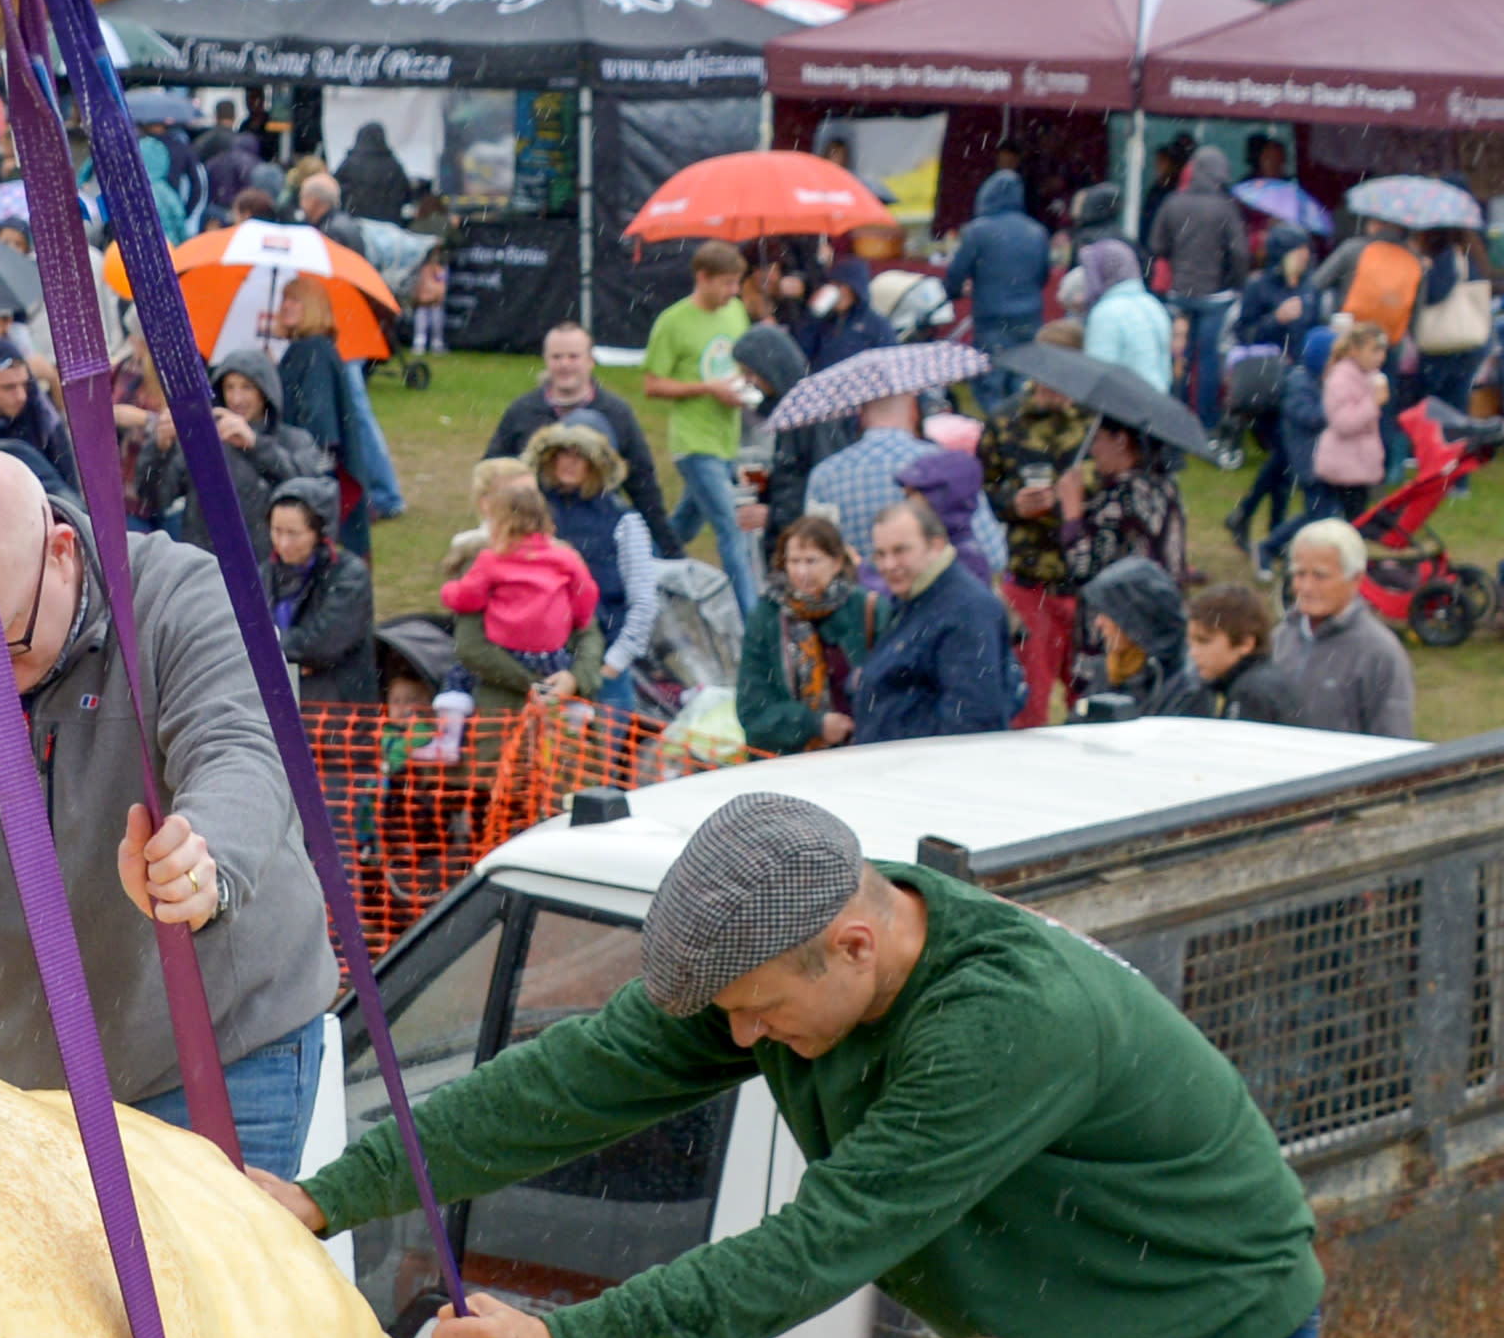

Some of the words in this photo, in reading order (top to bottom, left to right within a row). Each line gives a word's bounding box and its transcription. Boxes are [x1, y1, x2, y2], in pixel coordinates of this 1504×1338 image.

[382, 49, 454, 81] Pizza
[1170, 75, 1237, 105] Hearing
[1238, 77, 1283, 107] Dogs
[1284, 77, 1310, 104] for
[1354, 83, 1416, 111] People
